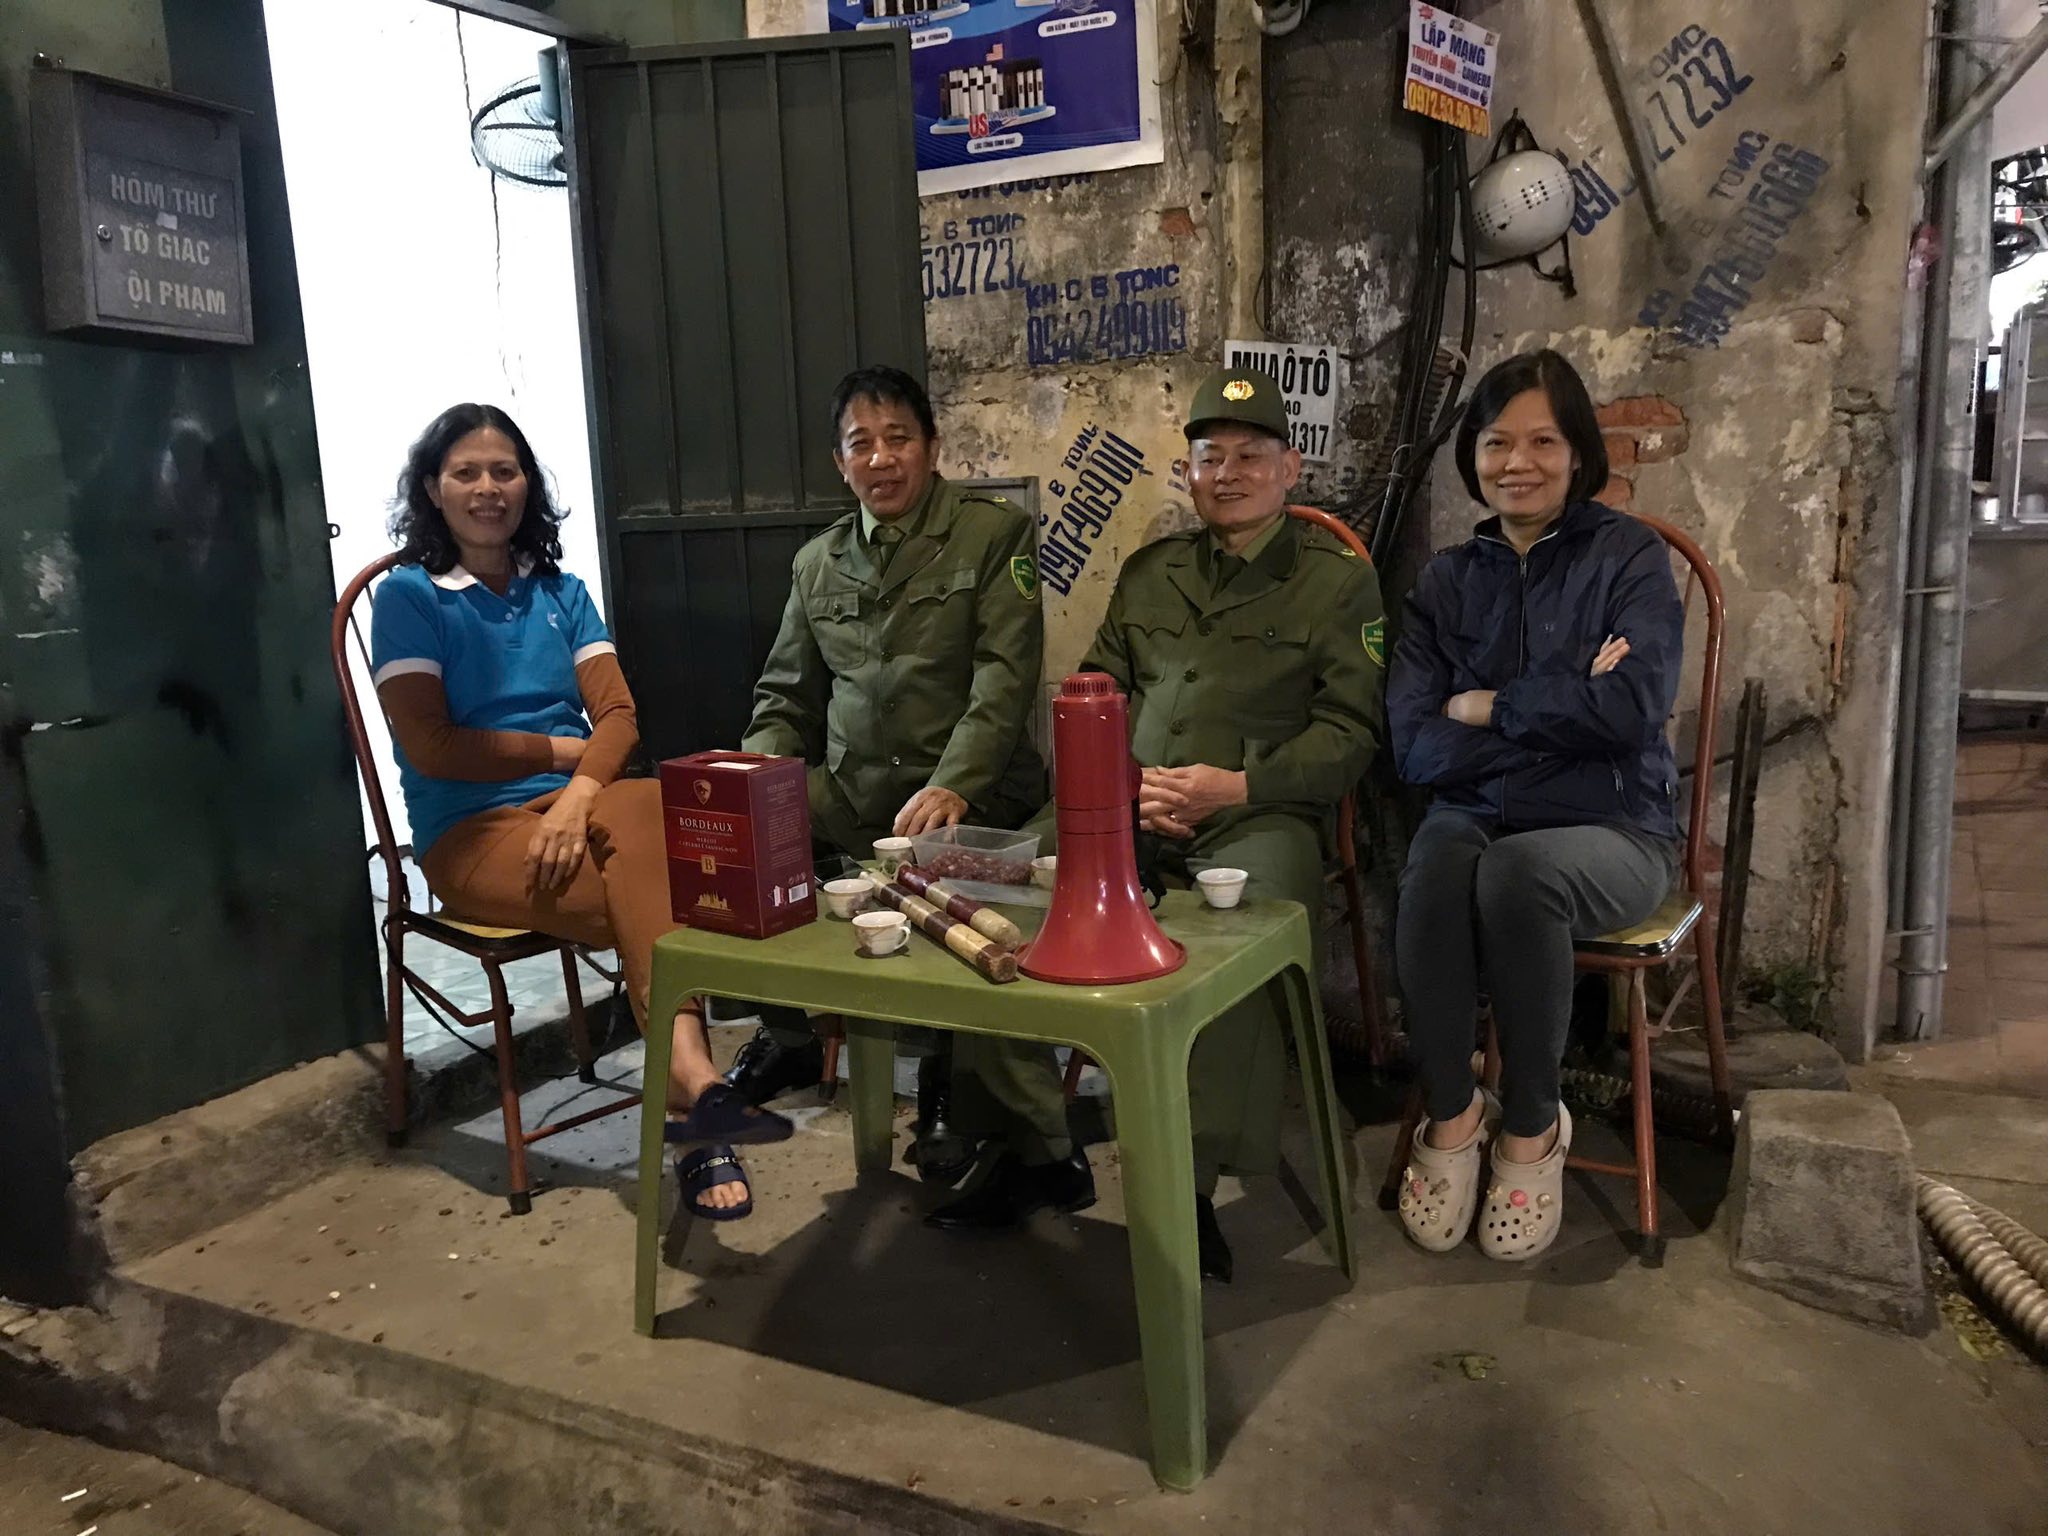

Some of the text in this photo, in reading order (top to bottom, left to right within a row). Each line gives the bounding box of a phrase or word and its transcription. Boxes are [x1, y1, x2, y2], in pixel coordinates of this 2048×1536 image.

[1421, 21, 1486, 66] LẮP MẠNG
[1462, 65, 1491, 88] CAMERA
[968, 112, 989, 138] US
[172, 187, 218, 219] THƯ
[159, 280, 226, 318] PHẠM
[1091, 275, 1109, 298] B
[679, 816, 733, 833] BORDEAUX
